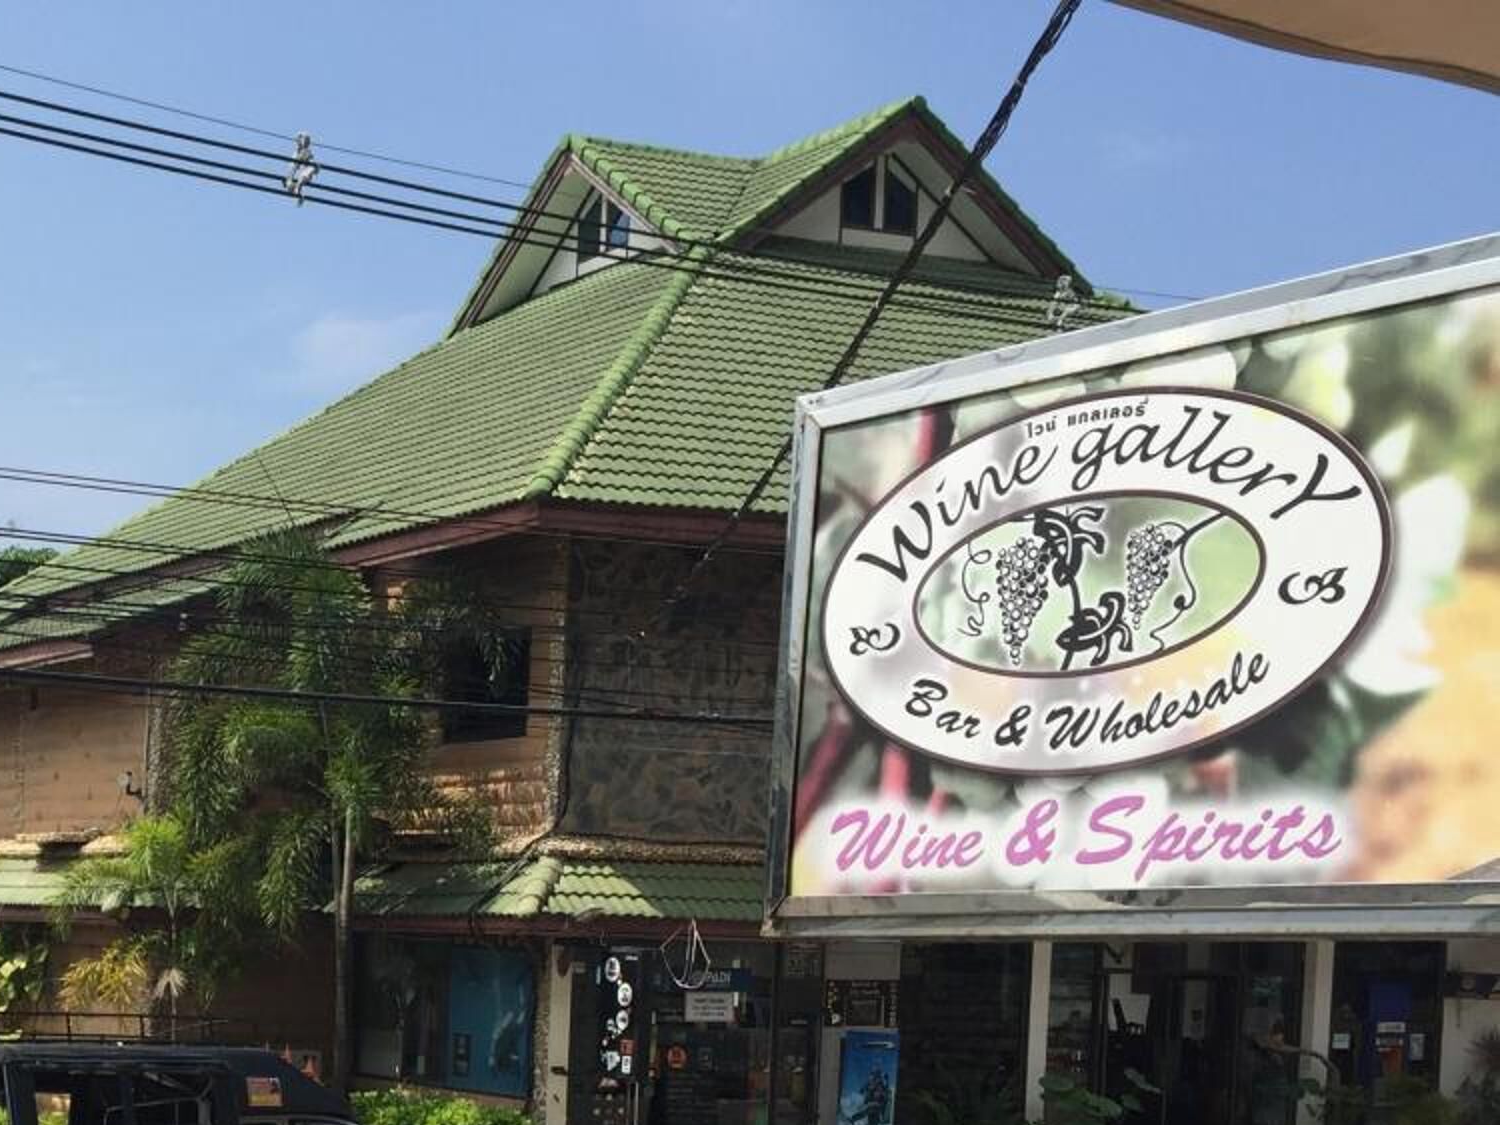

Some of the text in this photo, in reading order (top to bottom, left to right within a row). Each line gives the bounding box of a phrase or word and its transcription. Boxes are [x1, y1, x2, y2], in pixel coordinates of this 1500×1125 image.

[1025, 414, 1058, 439] ไวน์
[856, 440, 1057, 583] Wine
[904, 651, 1271, 751] Bar & Wholesale
[830, 795, 1343, 882] Wine & Spirits
